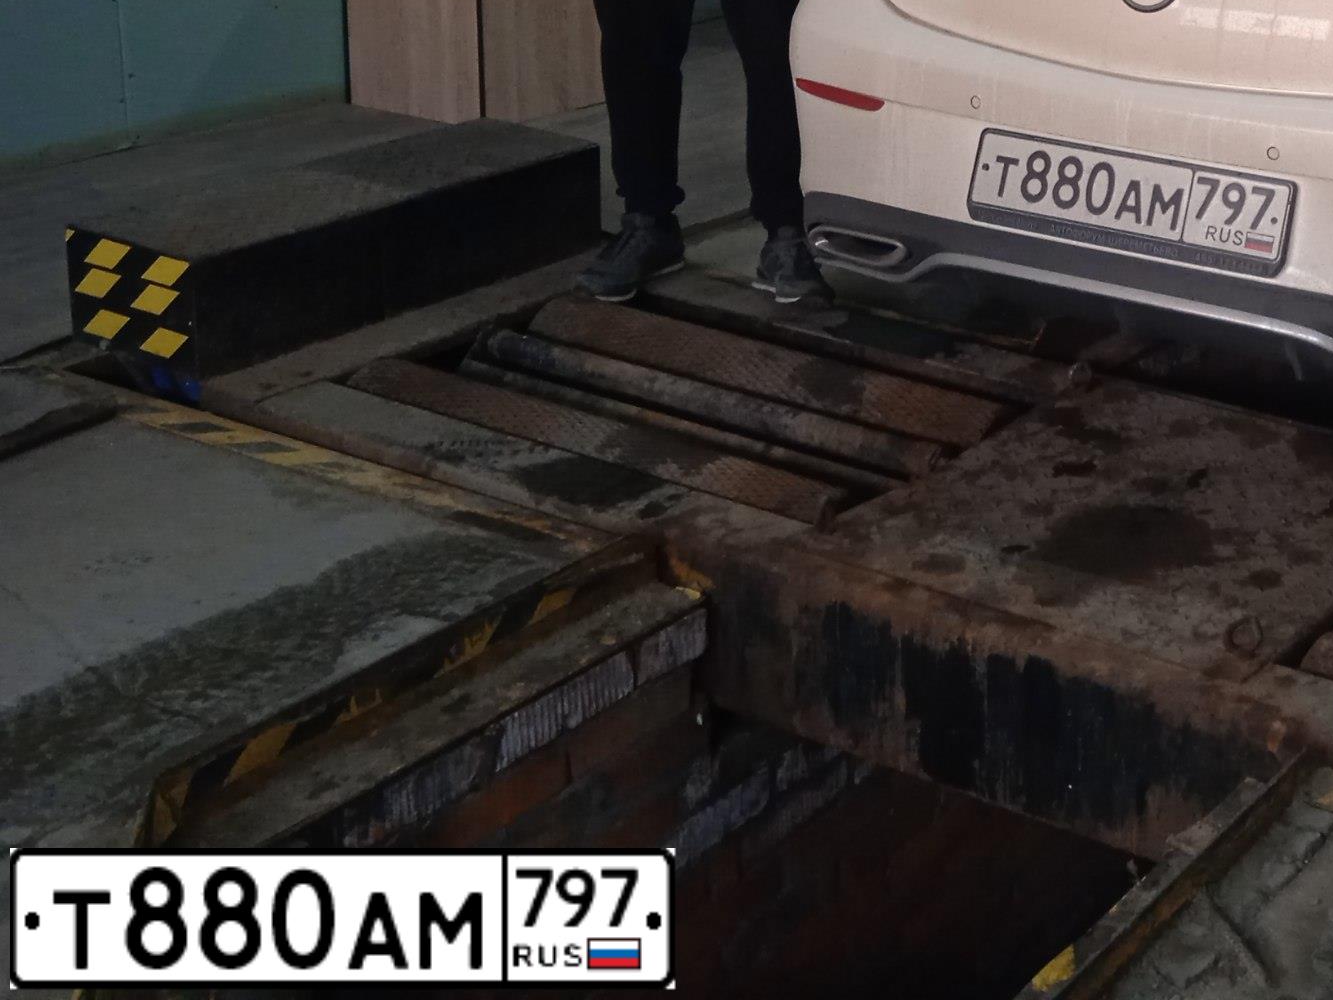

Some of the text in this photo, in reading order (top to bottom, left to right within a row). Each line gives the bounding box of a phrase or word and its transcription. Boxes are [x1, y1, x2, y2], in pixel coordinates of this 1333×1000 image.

[995, 150, 1277, 232] Т880АМ 797
[1205, 226, 1244, 247] RUS
